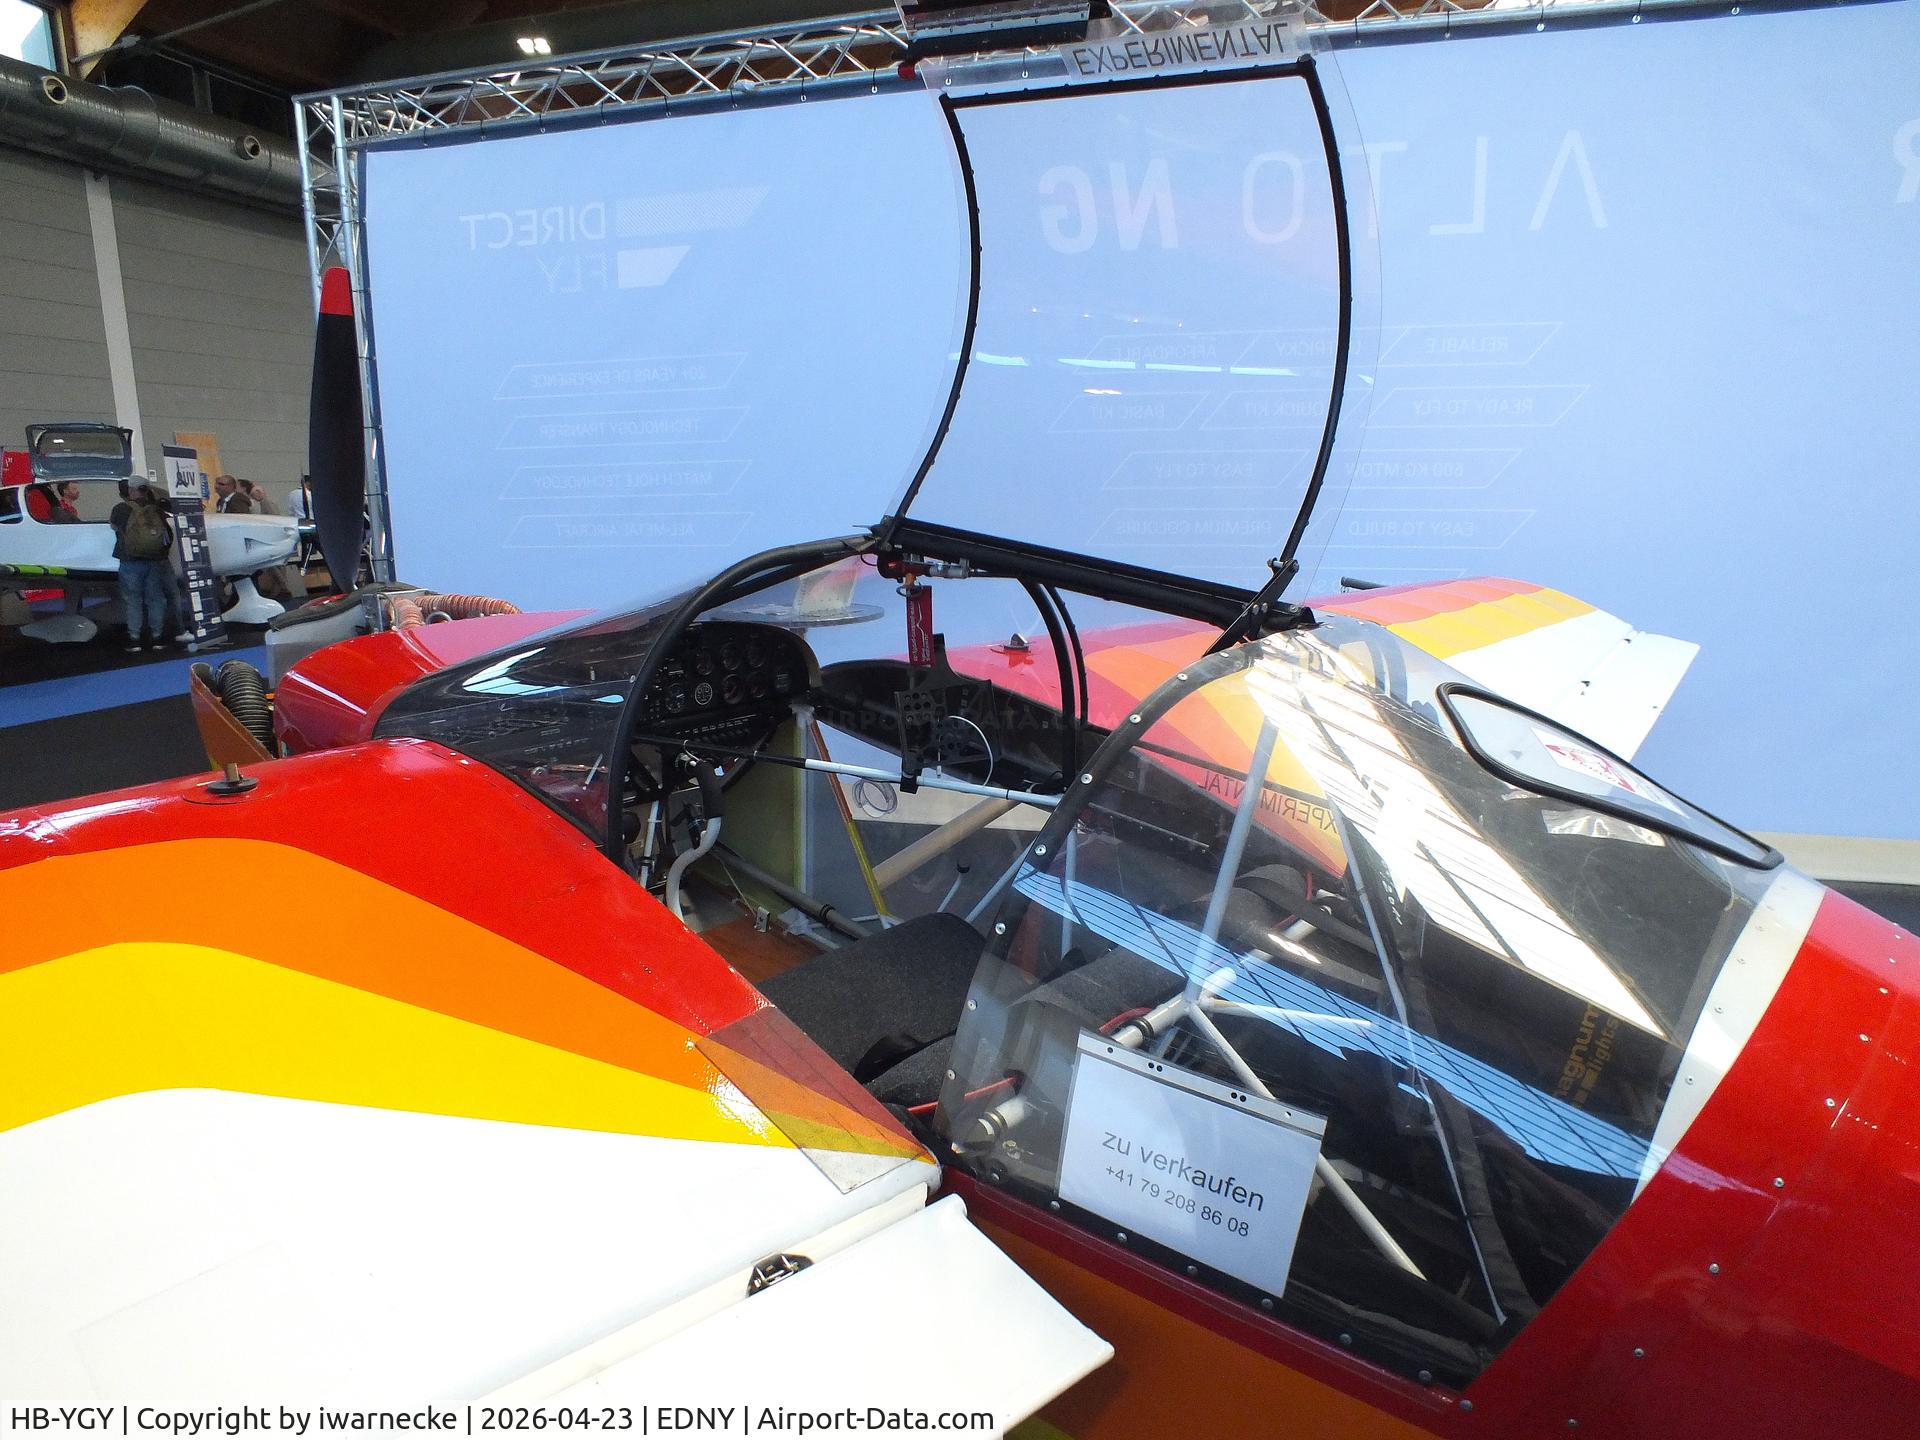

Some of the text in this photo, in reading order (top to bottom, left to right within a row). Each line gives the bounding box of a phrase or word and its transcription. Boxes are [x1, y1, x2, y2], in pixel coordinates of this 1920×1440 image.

[1102, 1132, 1264, 1211] zu verkaufen
[1106, 1165, 1249, 1237] +41 79 208 86 08
